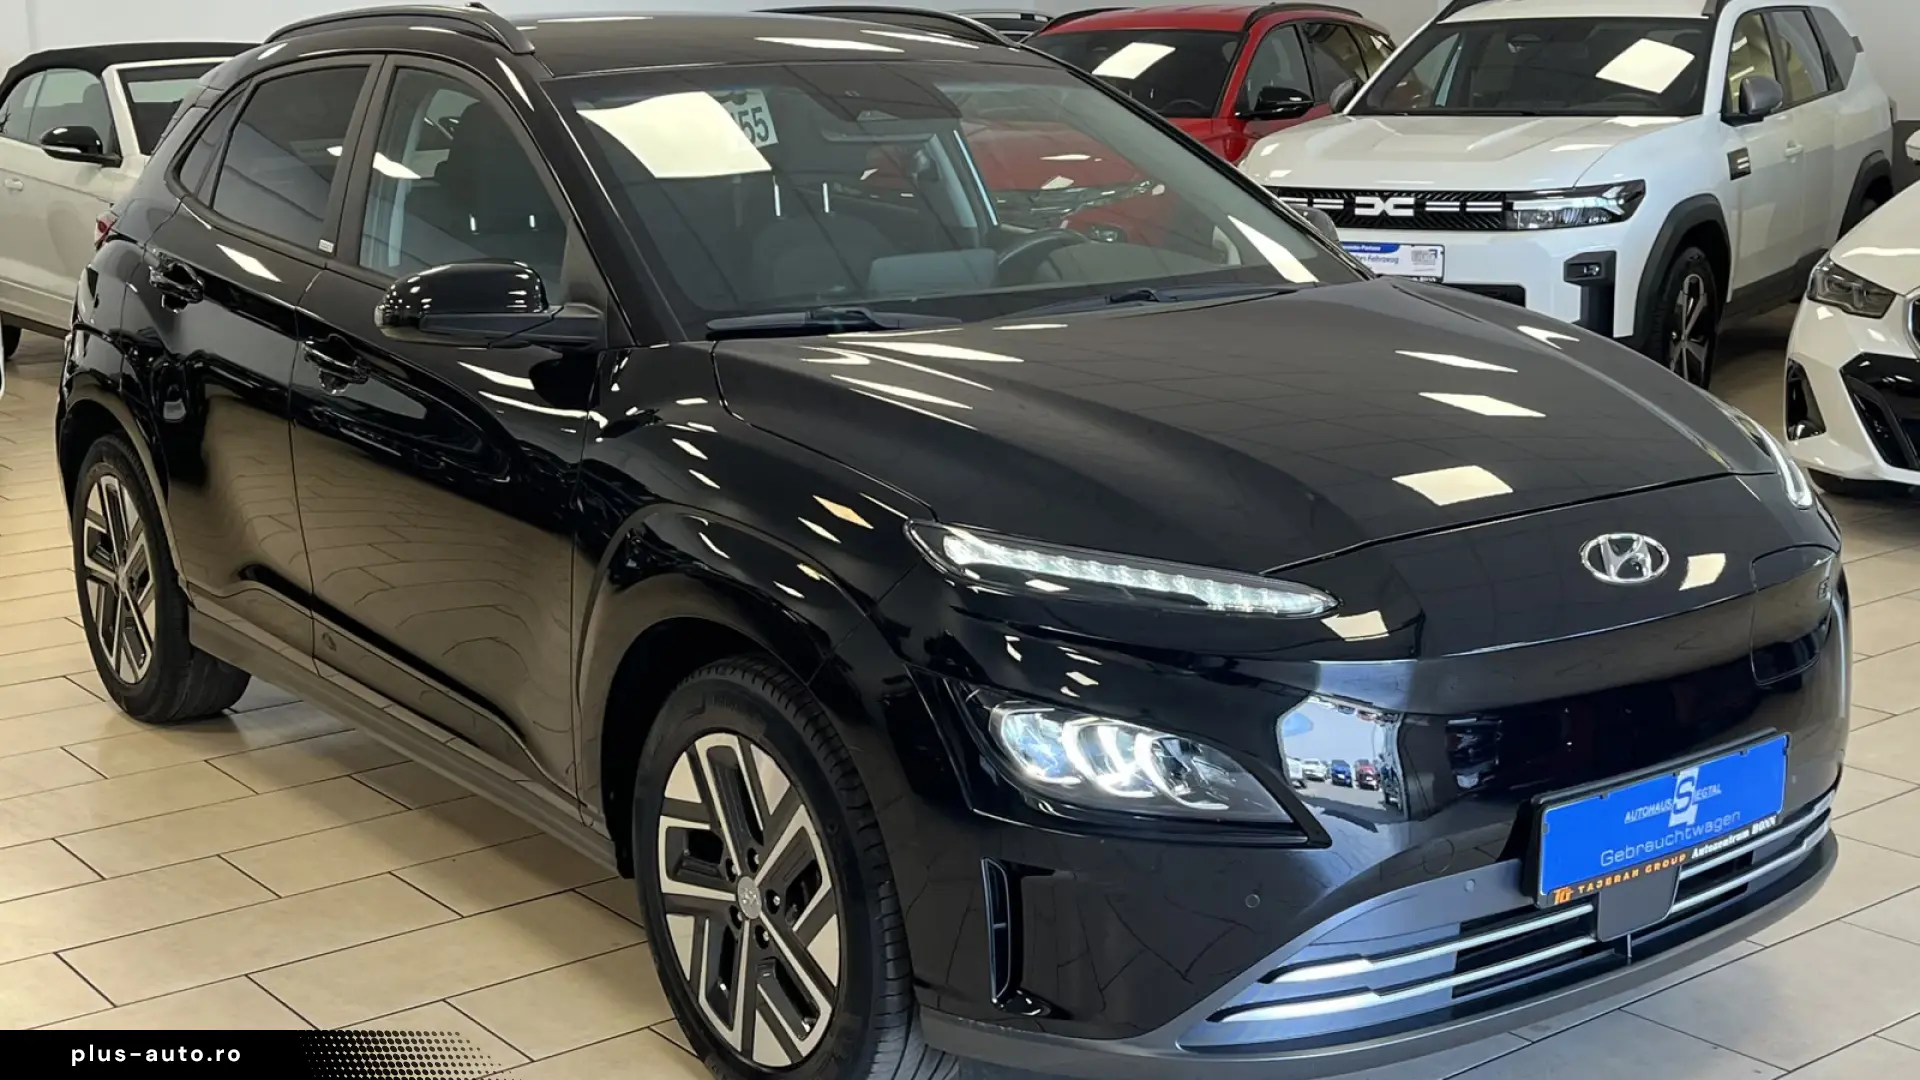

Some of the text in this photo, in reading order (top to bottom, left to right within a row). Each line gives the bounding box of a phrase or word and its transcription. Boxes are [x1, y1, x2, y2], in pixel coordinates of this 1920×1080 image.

[1624, 798, 1674, 825] AUTOHAUS
[1600, 811, 1741, 867] Gebrauchtwagen
[1645, 853, 1687, 874] GROUP
